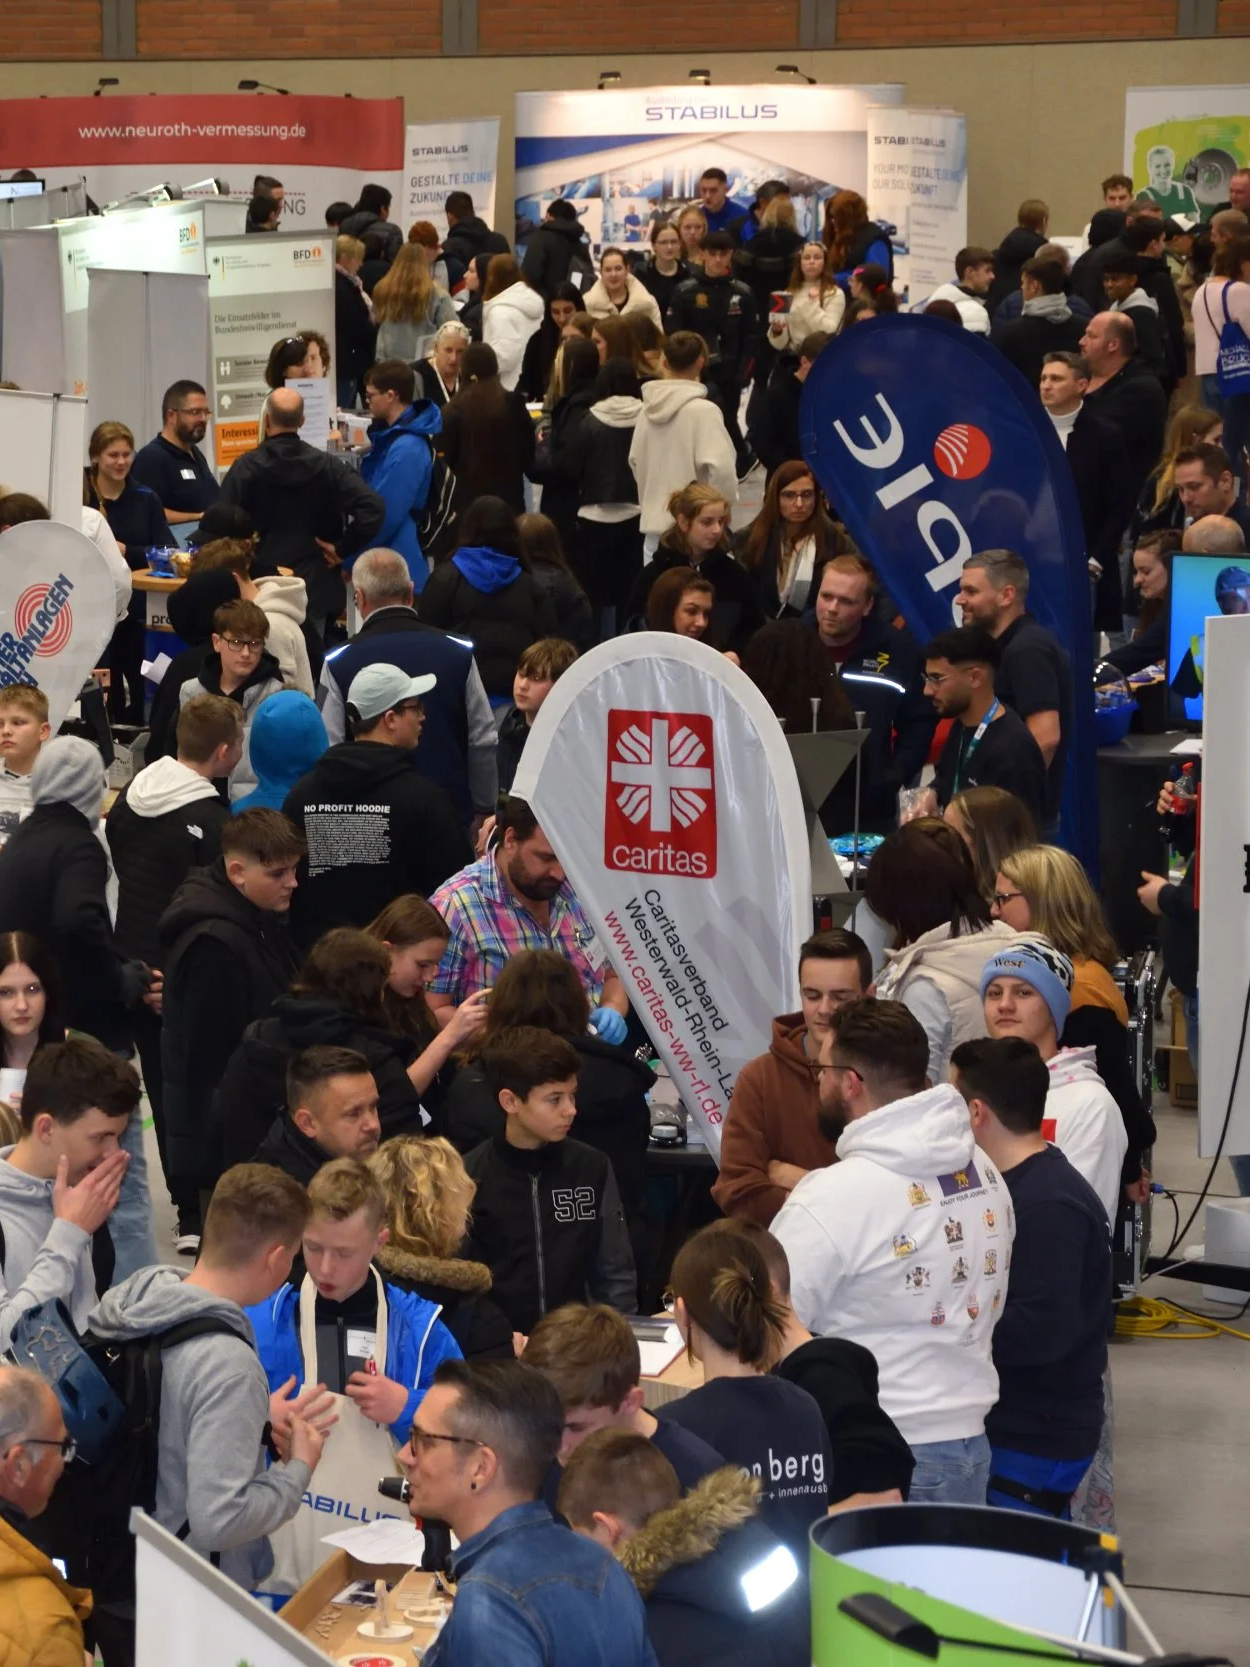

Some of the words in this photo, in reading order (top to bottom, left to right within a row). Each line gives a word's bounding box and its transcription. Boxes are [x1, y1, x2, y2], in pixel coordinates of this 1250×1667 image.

[646, 105, 778, 121] STABILUS
[78, 122, 307, 140] www.neuroth-vermessung.de
[874, 136, 909, 146] STABI
[412, 145, 469, 157] STABILUS
[410, 172, 460, 188] GESTALTE
[410, 191, 448, 204] ZUKUNF
[304, 805, 316, 813] NO
[318, 804, 354, 813] PROFIT
[355, 804, 391, 814] HOODIE
[612, 842, 708, 875] caritas
[644, 888, 729, 1032] Caritasverband
[604, 910, 723, 1125] www.caritas-ww-rl.de
[552, 1187, 596, 1222] 52
